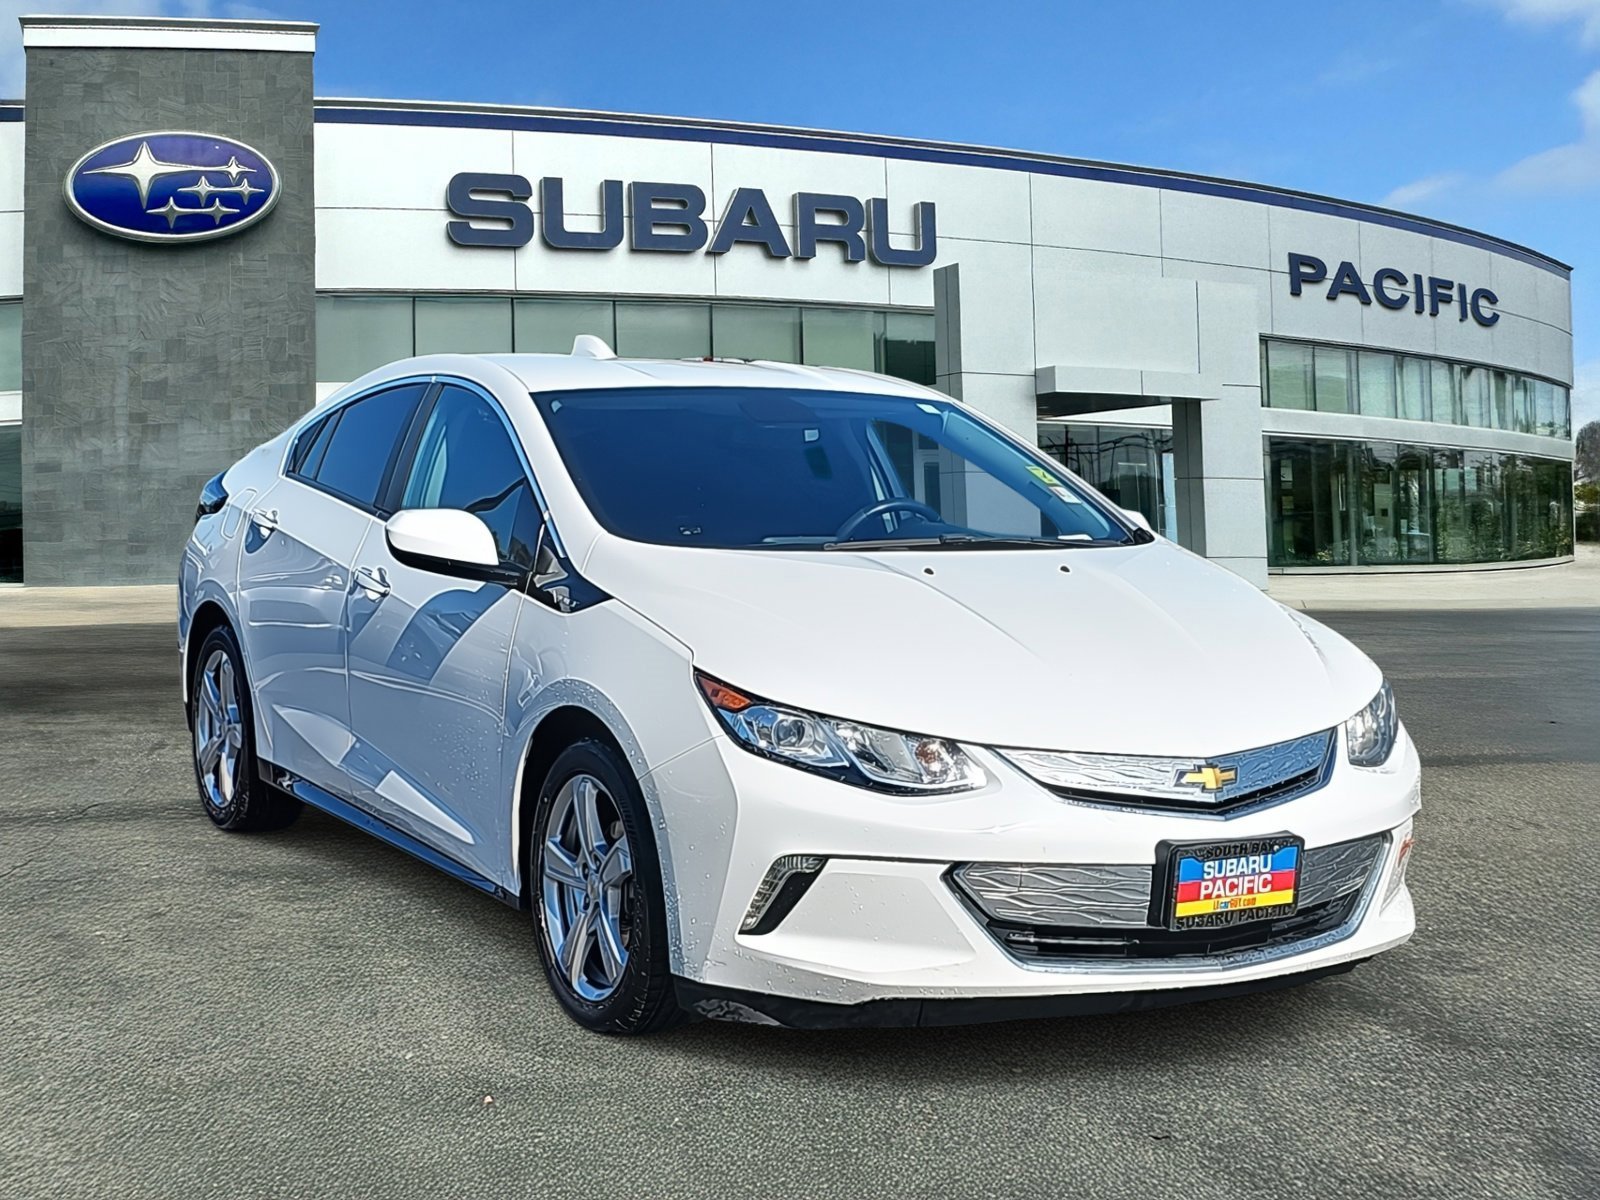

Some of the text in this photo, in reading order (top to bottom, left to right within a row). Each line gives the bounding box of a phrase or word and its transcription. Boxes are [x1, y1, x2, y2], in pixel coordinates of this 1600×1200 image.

[446, 171, 938, 267] SUBARU
[1288, 252, 1500, 326] PACIFIC
[1206, 842, 1248, 858] SOUTH
[1204, 855, 1272, 879] SUBARU
[1200, 874, 1272, 900] PACIFIC
